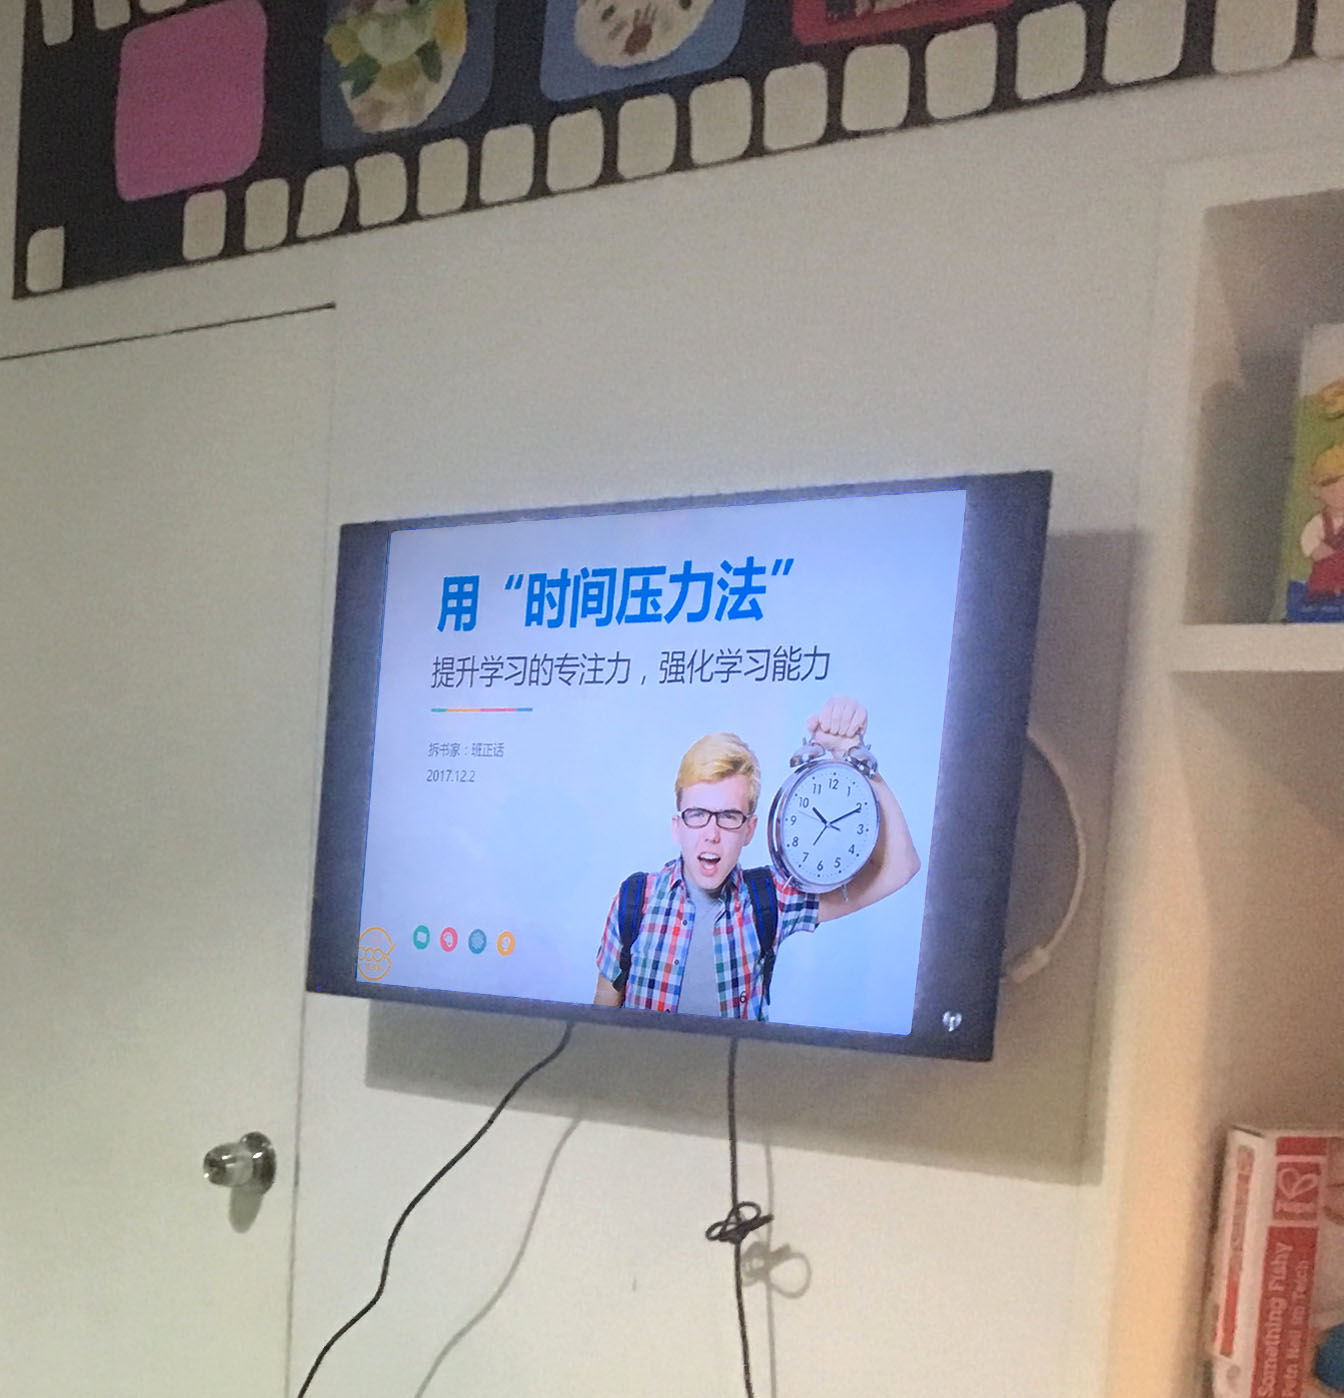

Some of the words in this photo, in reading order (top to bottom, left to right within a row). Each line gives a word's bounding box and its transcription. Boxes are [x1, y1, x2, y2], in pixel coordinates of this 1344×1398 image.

[431, 645, 830, 688] 提升学习的专注力，强化学习能力
[426, 768, 476, 783] 2017.12.2
[812, 784, 822, 795] 11
[828, 778, 839, 790] 12
[799, 796, 810, 808] 10
[790, 815, 797, 826] 9
[857, 824, 864, 835] 3
[792, 836, 799, 847] 8
[848, 844, 855, 855] 4
[802, 852, 809, 862] 7
[834, 857, 841, 868] 5
[817, 860, 824, 871] 6
[1268, 1241, 1294, 1292] Fishy
[1257, 1297, 1288, 1397] Something
